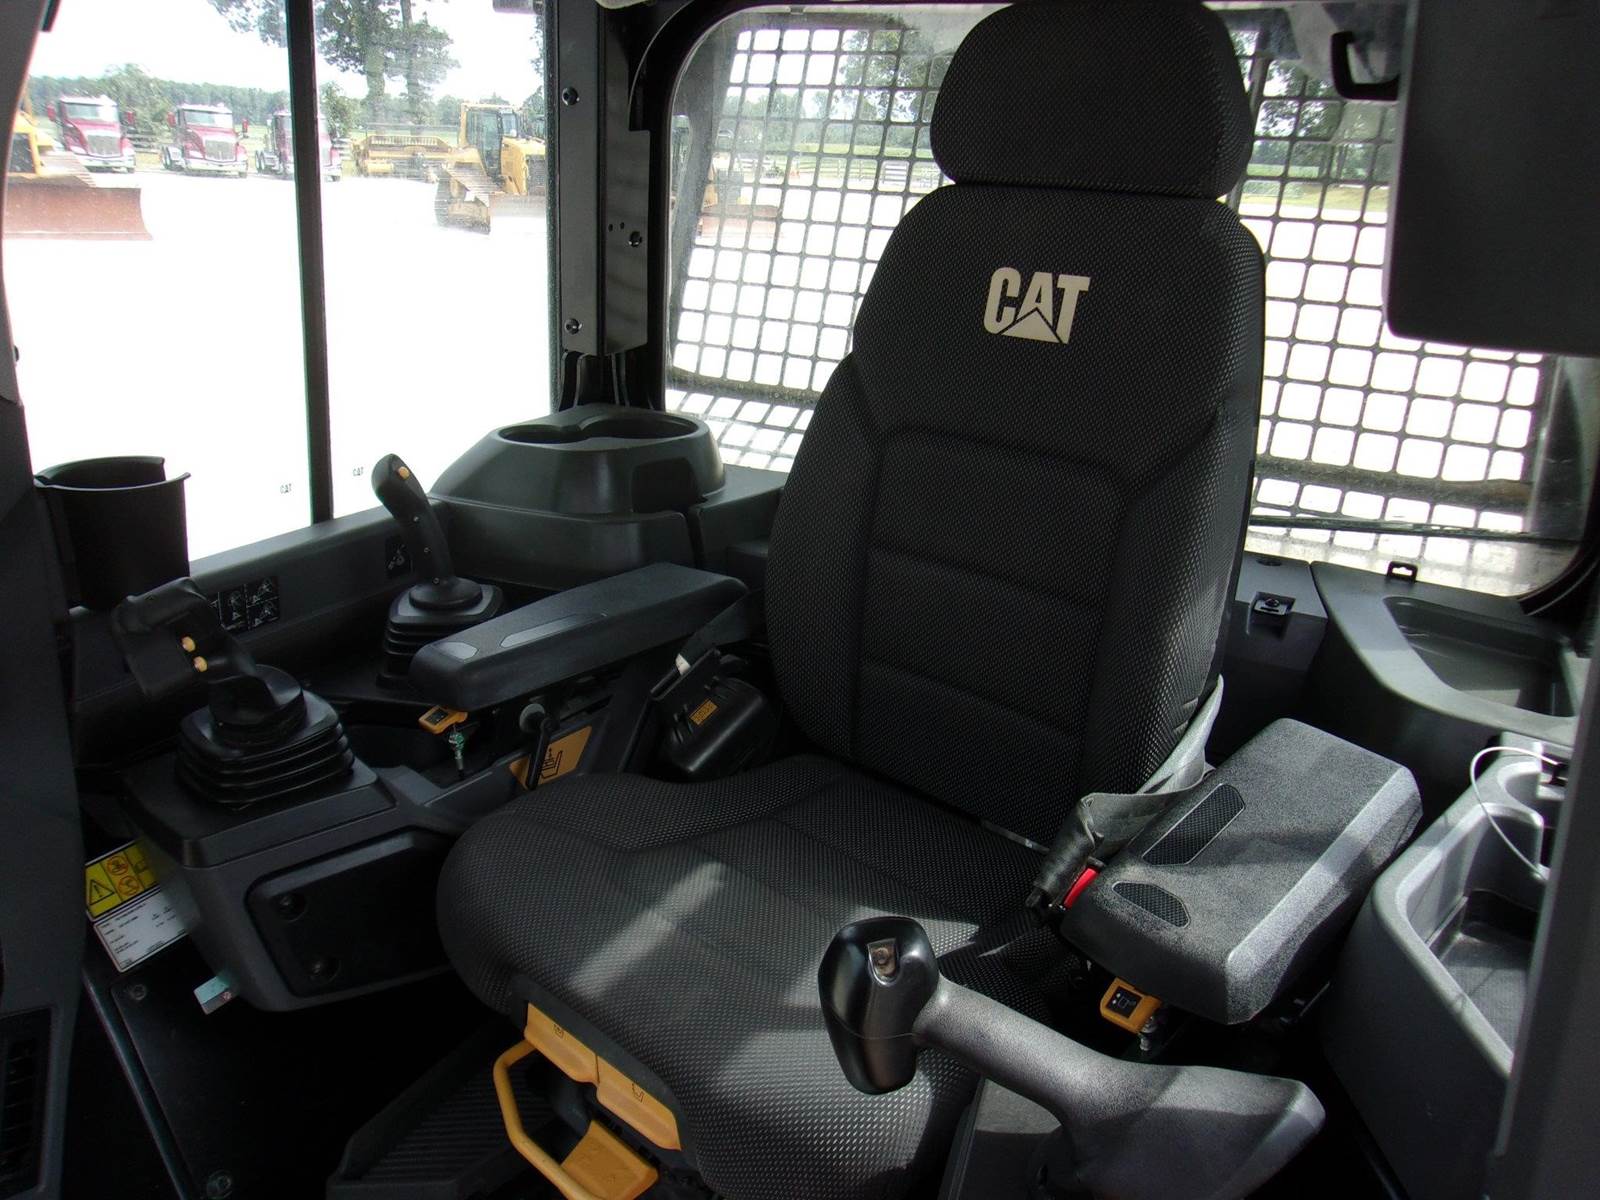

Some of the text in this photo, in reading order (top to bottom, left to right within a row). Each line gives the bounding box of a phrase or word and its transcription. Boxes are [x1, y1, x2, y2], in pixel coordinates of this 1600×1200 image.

[984, 266, 1091, 344] CAT
[352, 466, 364, 477] CAT
[280, 483, 292, 494] CAT
